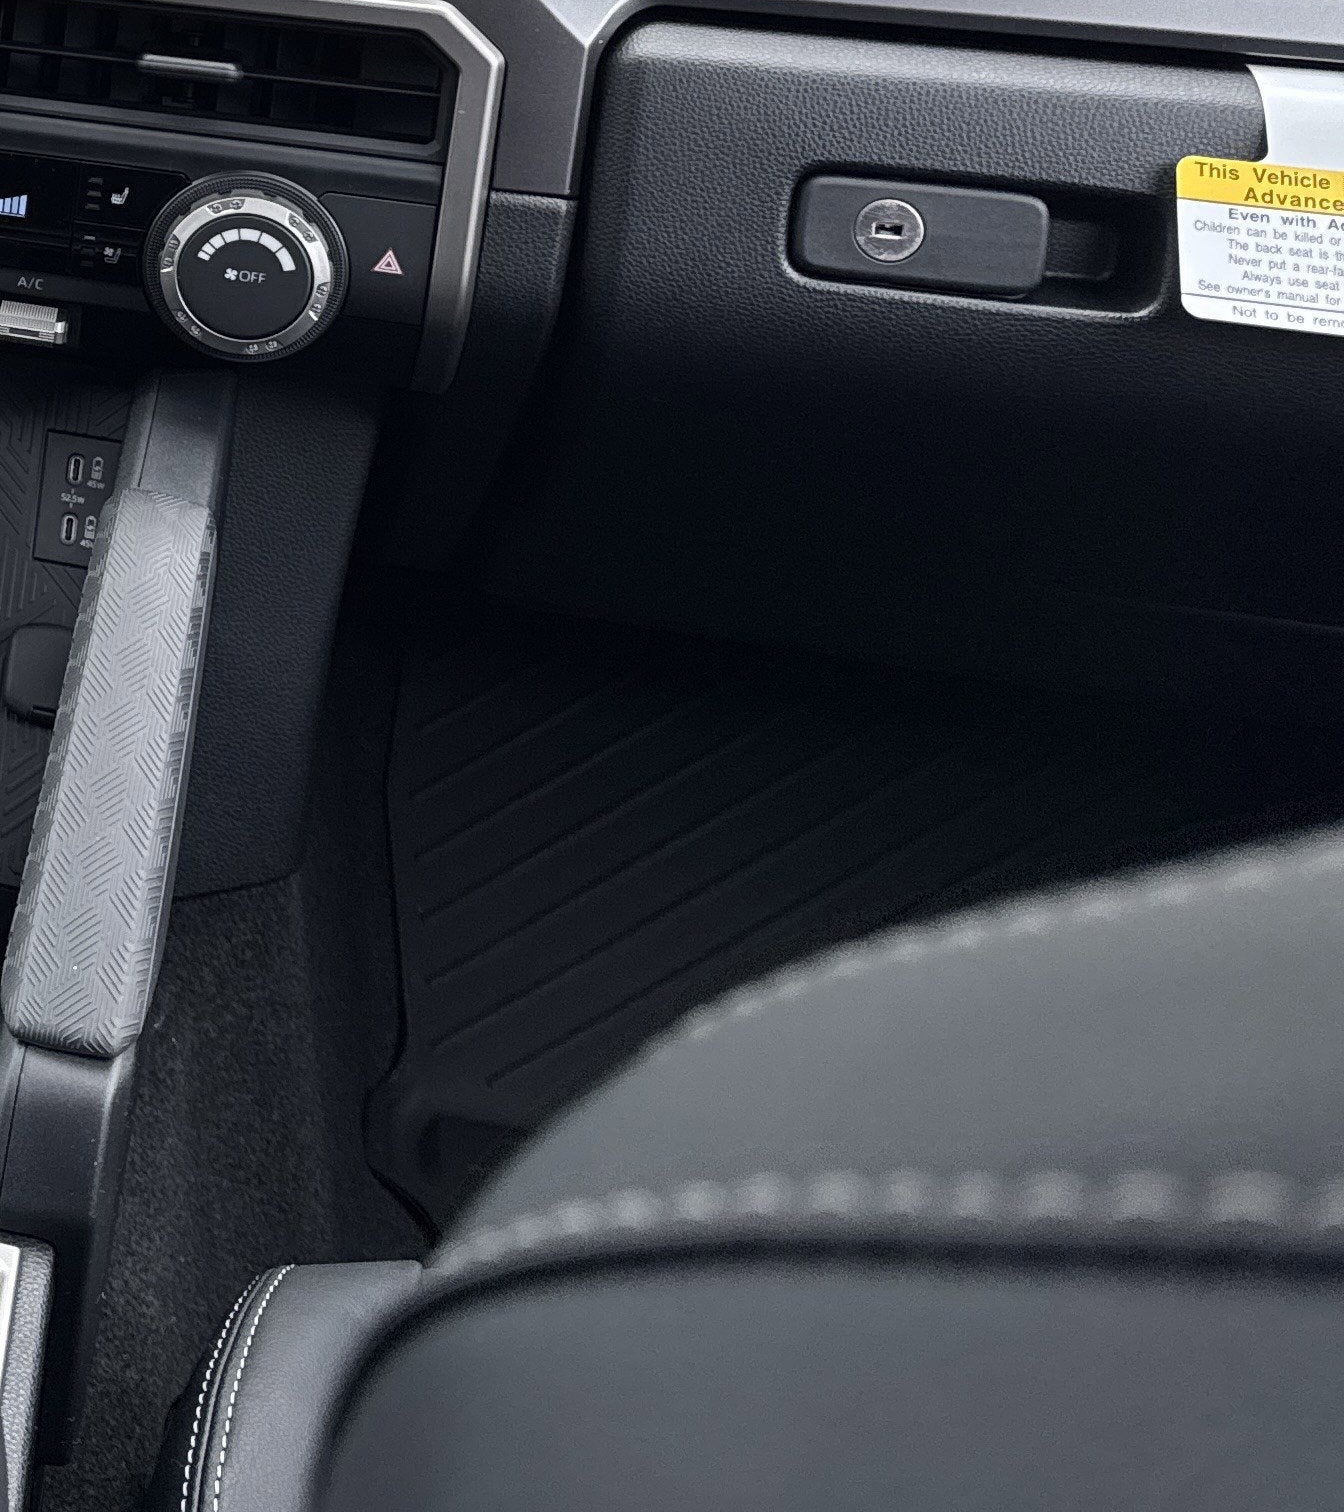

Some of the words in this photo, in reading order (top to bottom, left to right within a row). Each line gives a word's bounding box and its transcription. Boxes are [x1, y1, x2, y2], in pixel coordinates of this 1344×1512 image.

[1194, 161, 1240, 181] This
[1252, 167, 1331, 190] Vehicle
[1228, 208, 1270, 224] Even
[1281, 215, 1317, 229] with
[1193, 219, 1241, 235] Children
[1246, 228, 1267, 239] can
[1273, 228, 1288, 240] be
[1294, 231, 1324, 245] killed
[1329, 237, 1341, 246] or
[1227, 238, 1249, 251] The
[1255, 242, 1282, 254] back
[1288, 247, 1313, 258] seat
[1319, 249, 1329, 260] is
[1228, 253, 1262, 267] Never
[1269, 259, 1286, 271] put
[1293, 263, 1300, 272] a
[16, 276, 44, 290] A/C
[238, 269, 267, 284] OFF
[1241, 270, 1281, 286] Always
[1288, 277, 1309, 288] use
[1315, 279, 1340, 291] seat
[1198, 279, 1220, 292] See
[1227, 285, 1271, 298] owner's
[1276, 290, 1319, 304] manual
[1325, 294, 1341, 306] for
[1231, 305, 1257, 318] Not
[1265, 309, 1279, 321] to
[1287, 312, 1305, 324] be
